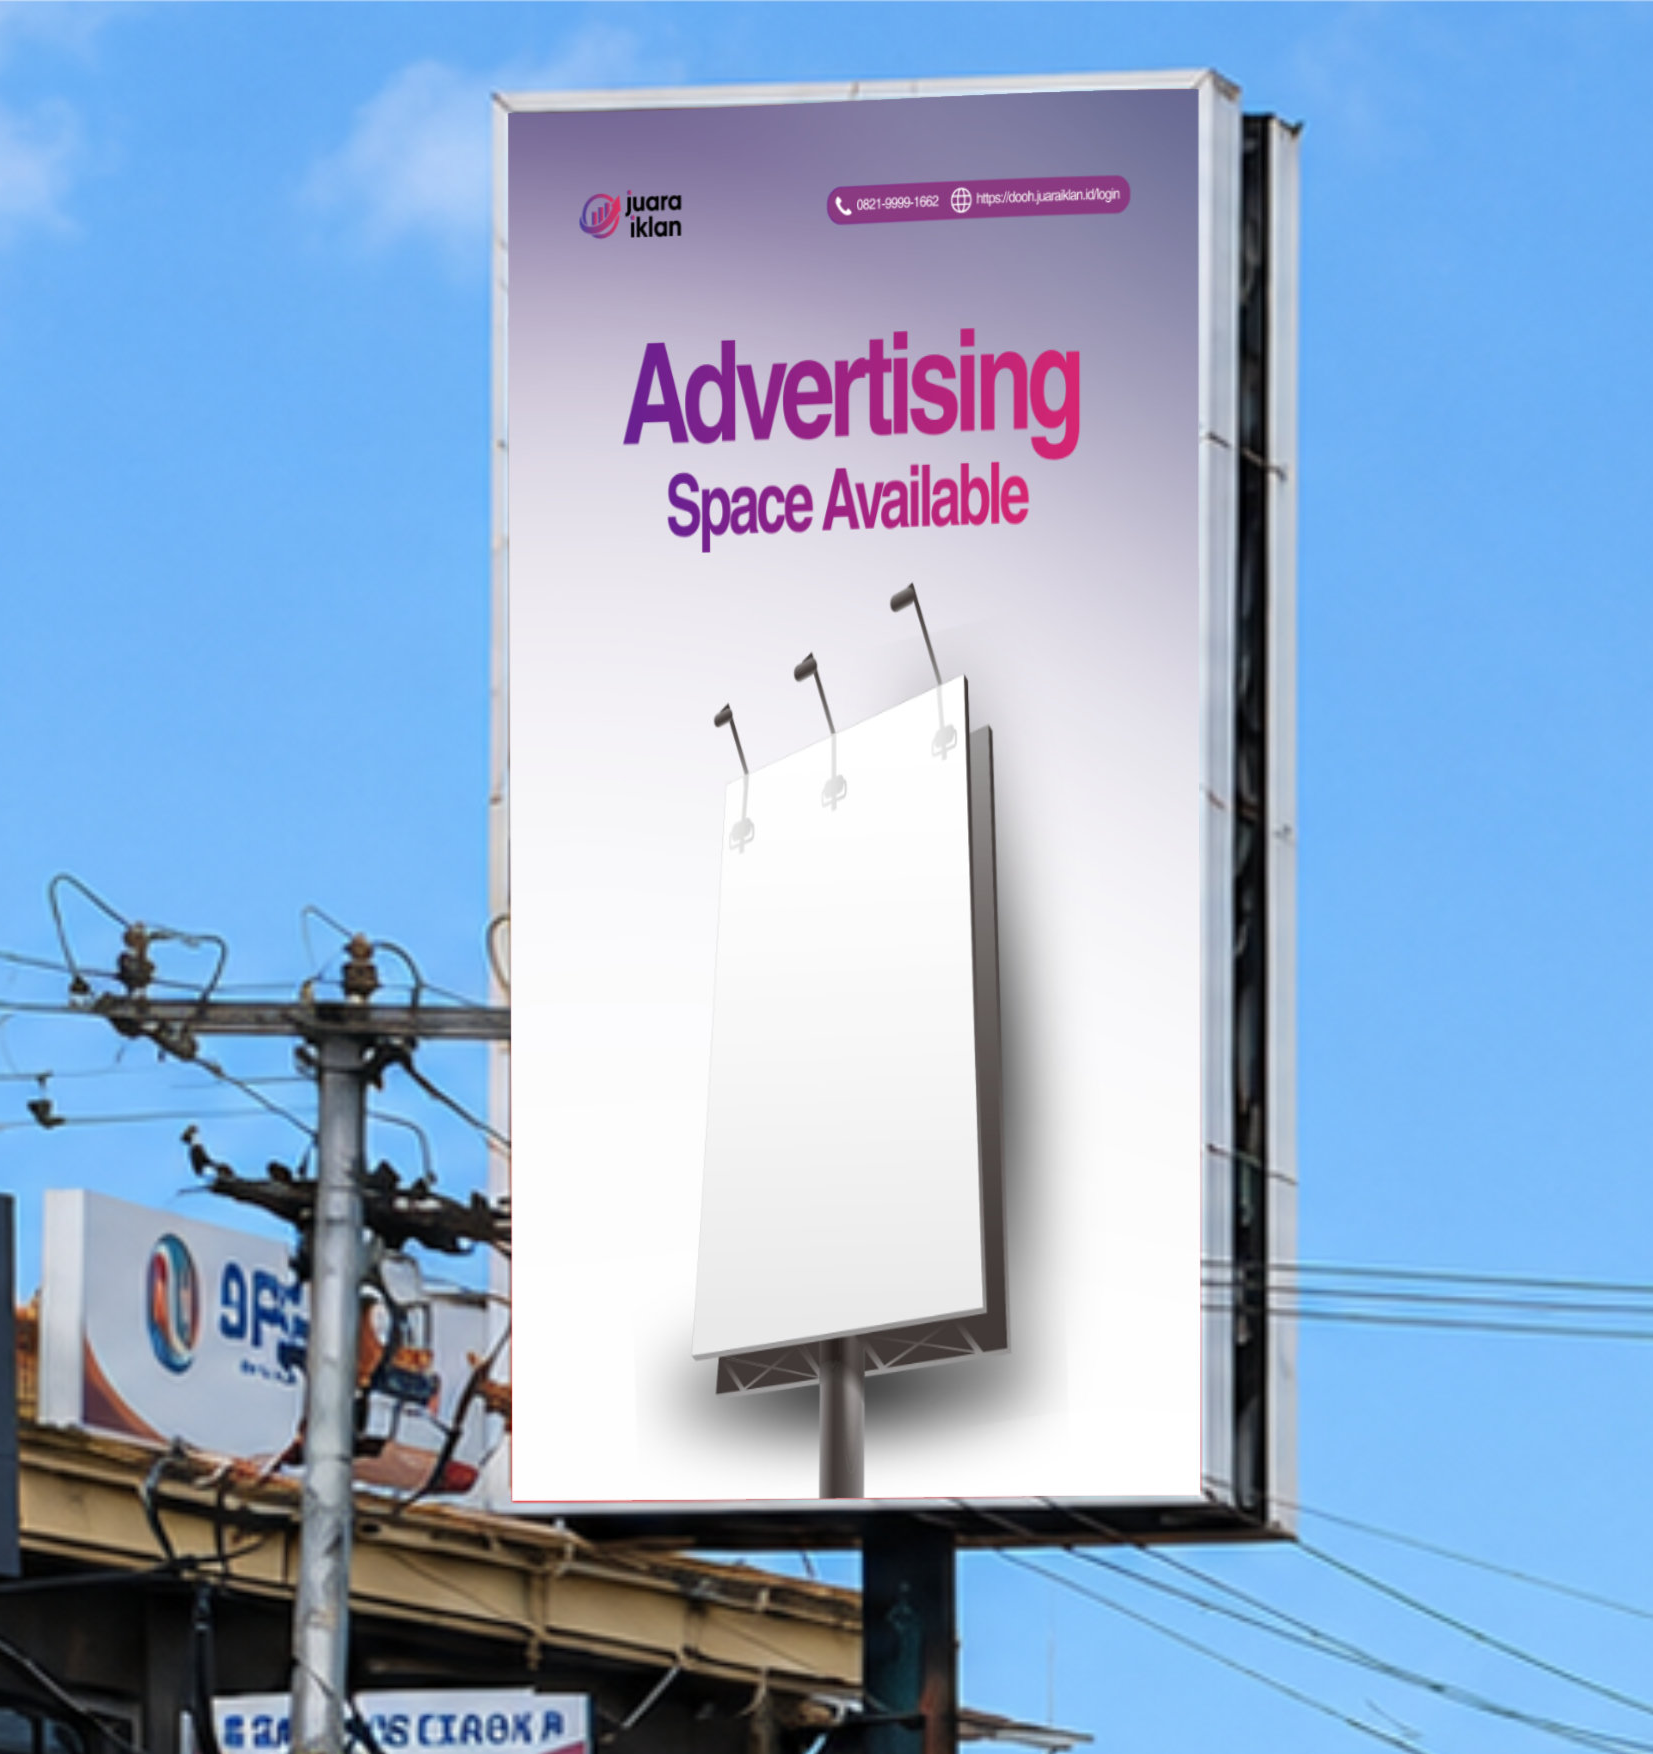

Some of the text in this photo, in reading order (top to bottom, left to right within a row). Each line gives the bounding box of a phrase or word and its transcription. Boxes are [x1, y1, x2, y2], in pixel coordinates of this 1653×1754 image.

[625, 189, 682, 217] juara
[856, 195, 939, 211] 0821-9999-1662
[630, 215, 682, 238] iklan
[623, 328, 1081, 459] Advertising
[667, 462, 1029, 553] Space Available
